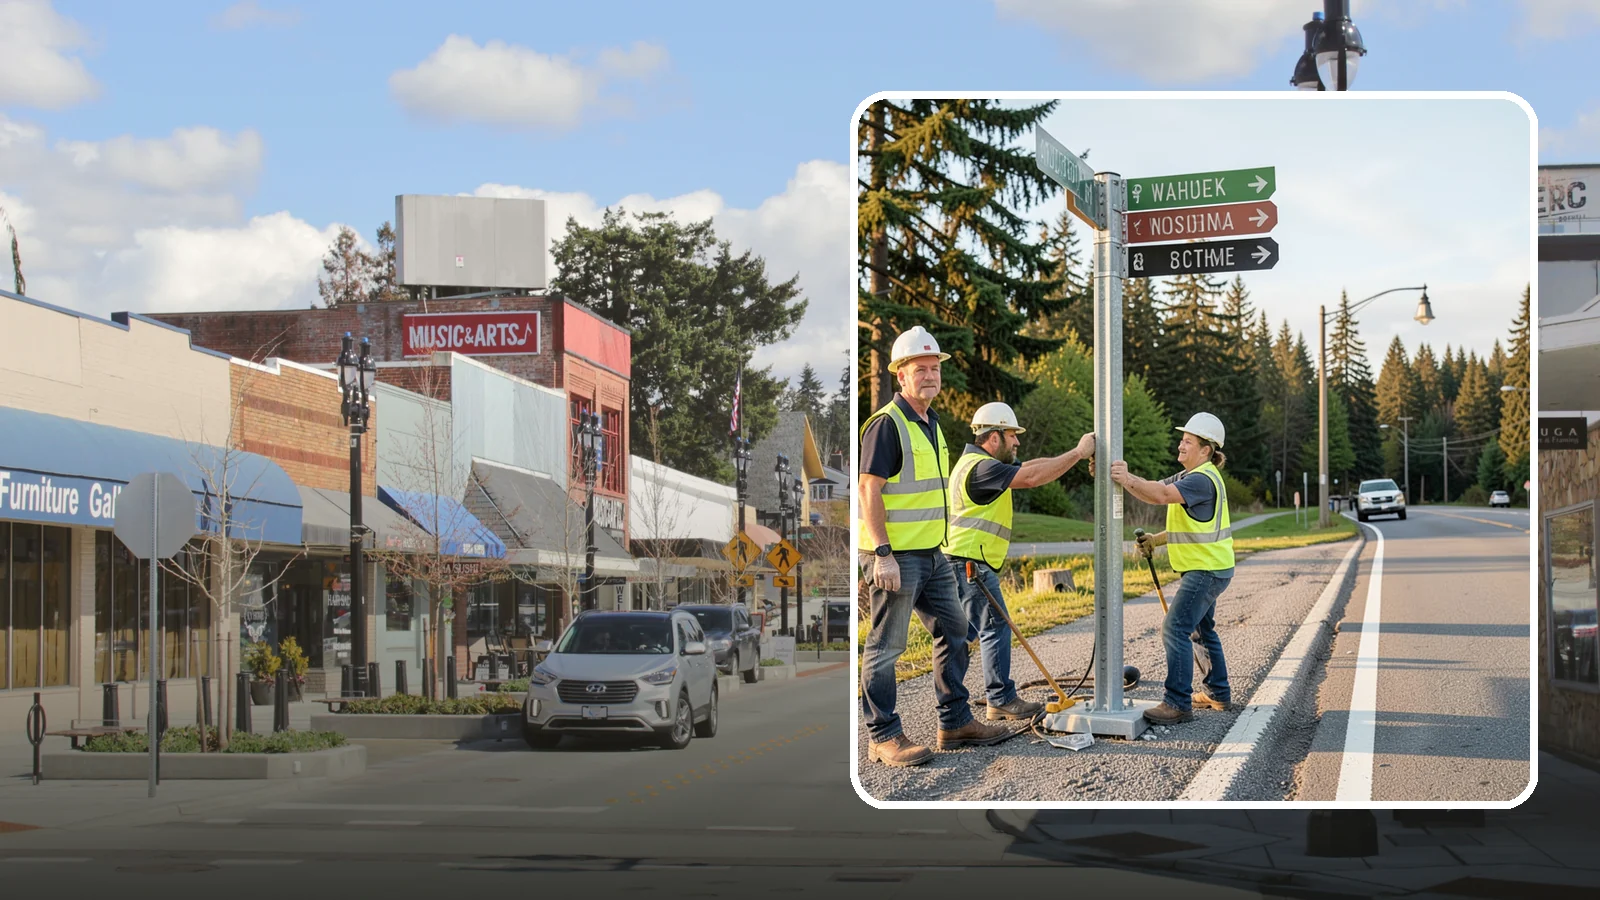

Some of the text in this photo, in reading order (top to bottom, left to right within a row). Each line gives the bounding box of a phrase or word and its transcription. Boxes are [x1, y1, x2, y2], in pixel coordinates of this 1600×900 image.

[1551, 436, 1579, 444] Framing
[0, 470, 122, 519] Furniture Gal
[453, 563, 479, 574] SUSHI
